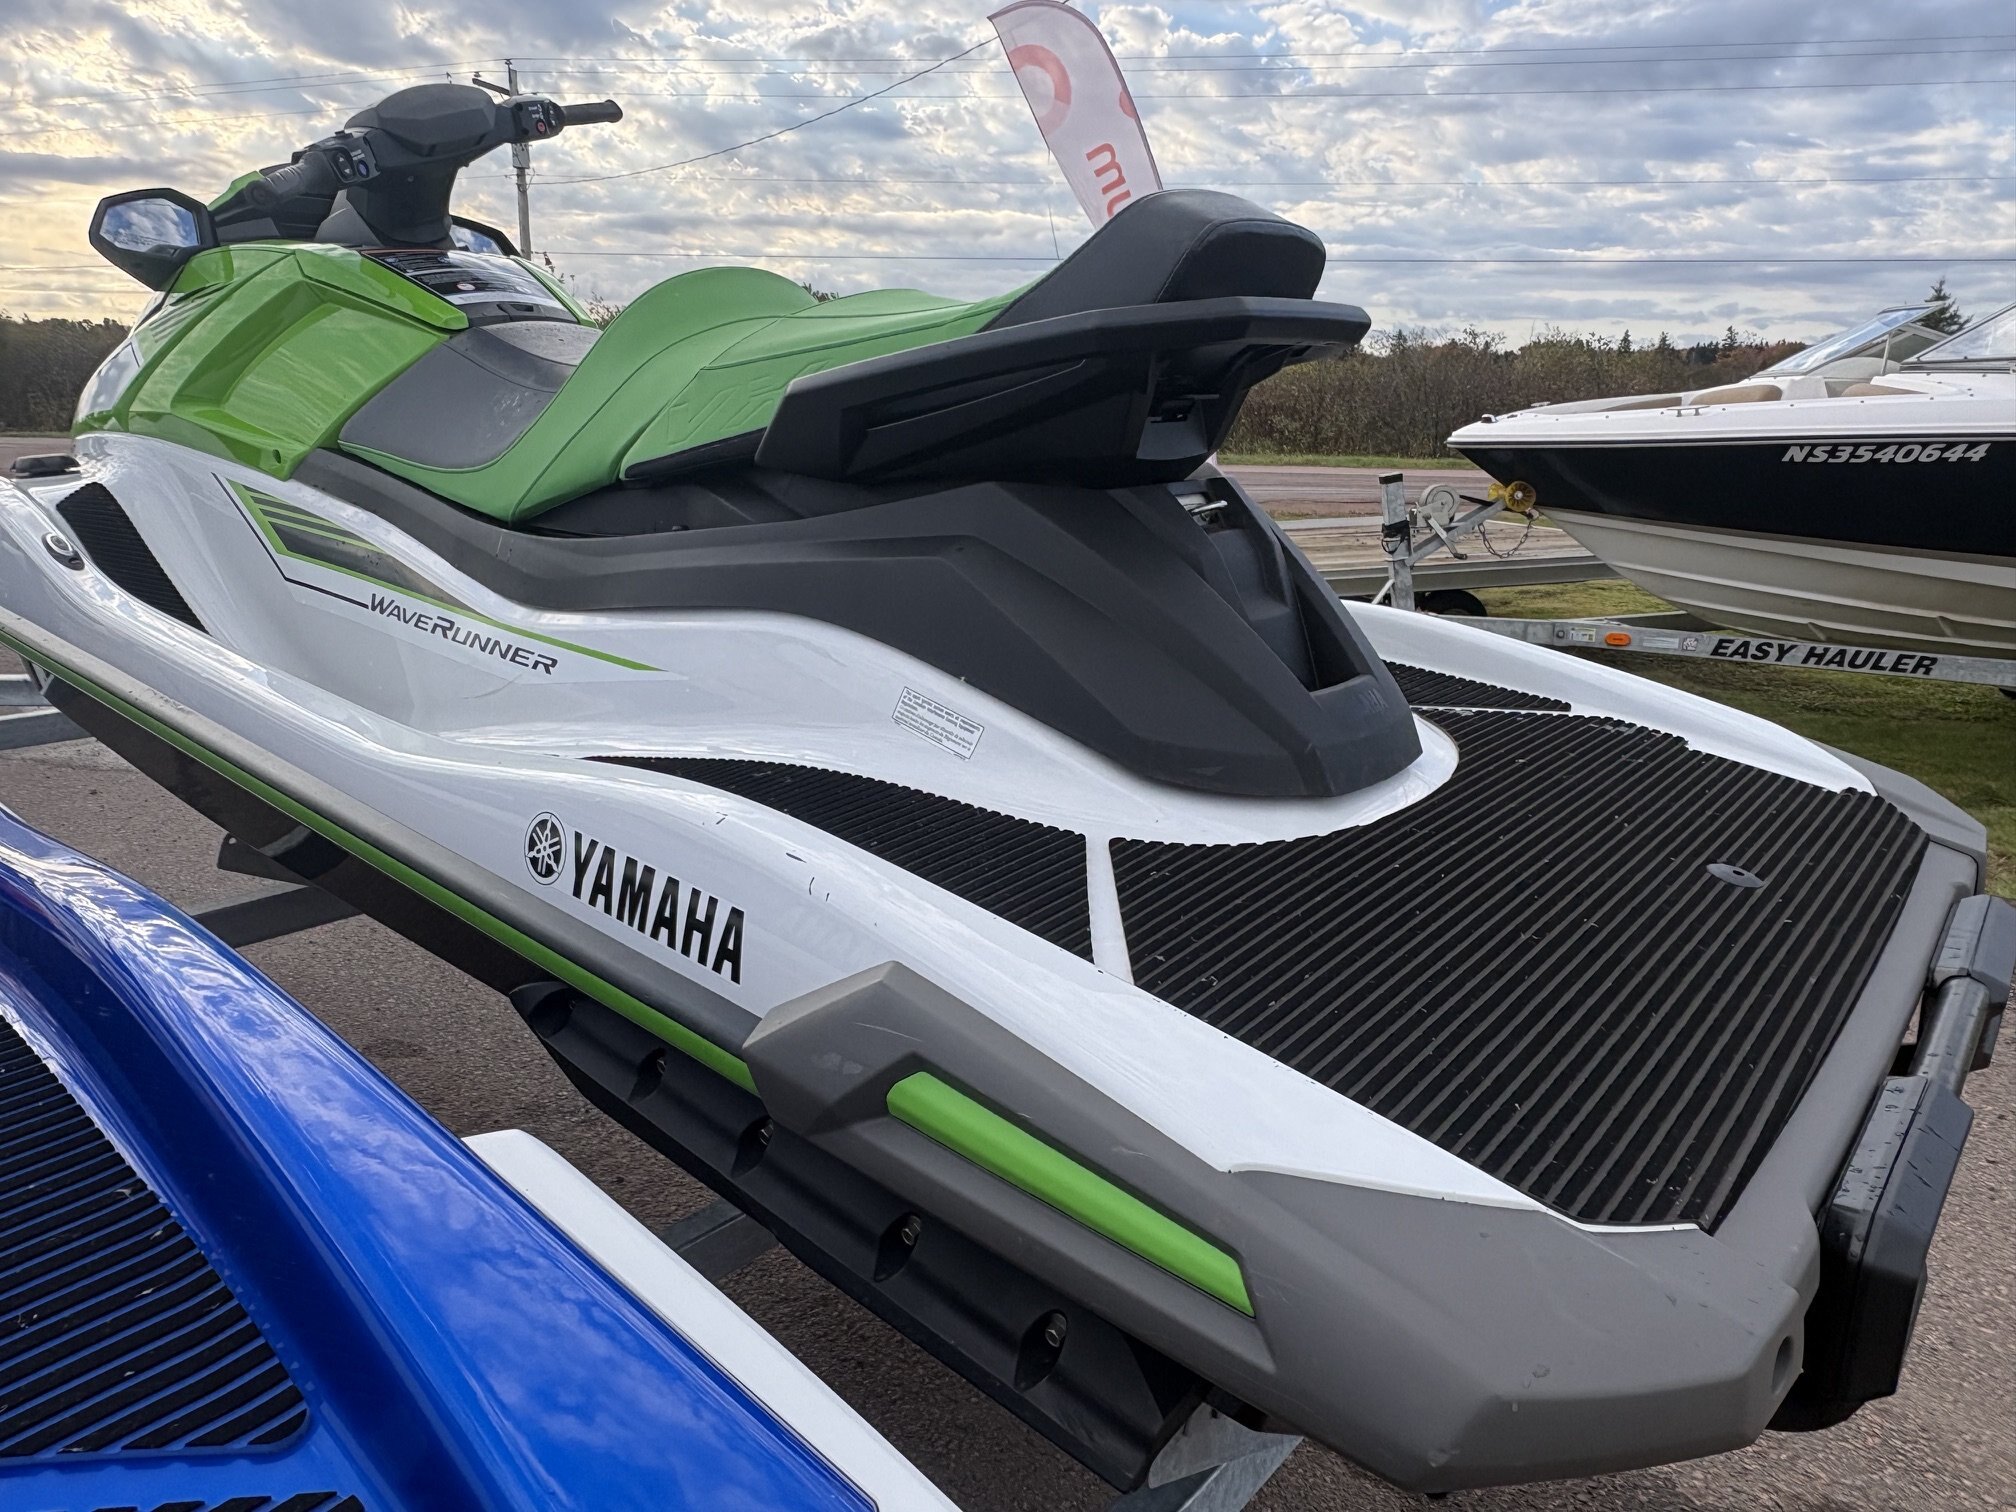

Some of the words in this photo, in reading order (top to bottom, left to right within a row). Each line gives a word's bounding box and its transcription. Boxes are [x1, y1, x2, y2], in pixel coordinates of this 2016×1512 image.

[1781, 443, 1992, 463] NS3540644
[369, 593, 558, 675] WAVERUNNER
[1709, 638, 1798, 662] EASY
[1800, 646, 1938, 676] HAULER
[572, 830, 745, 985] YAMAHA
